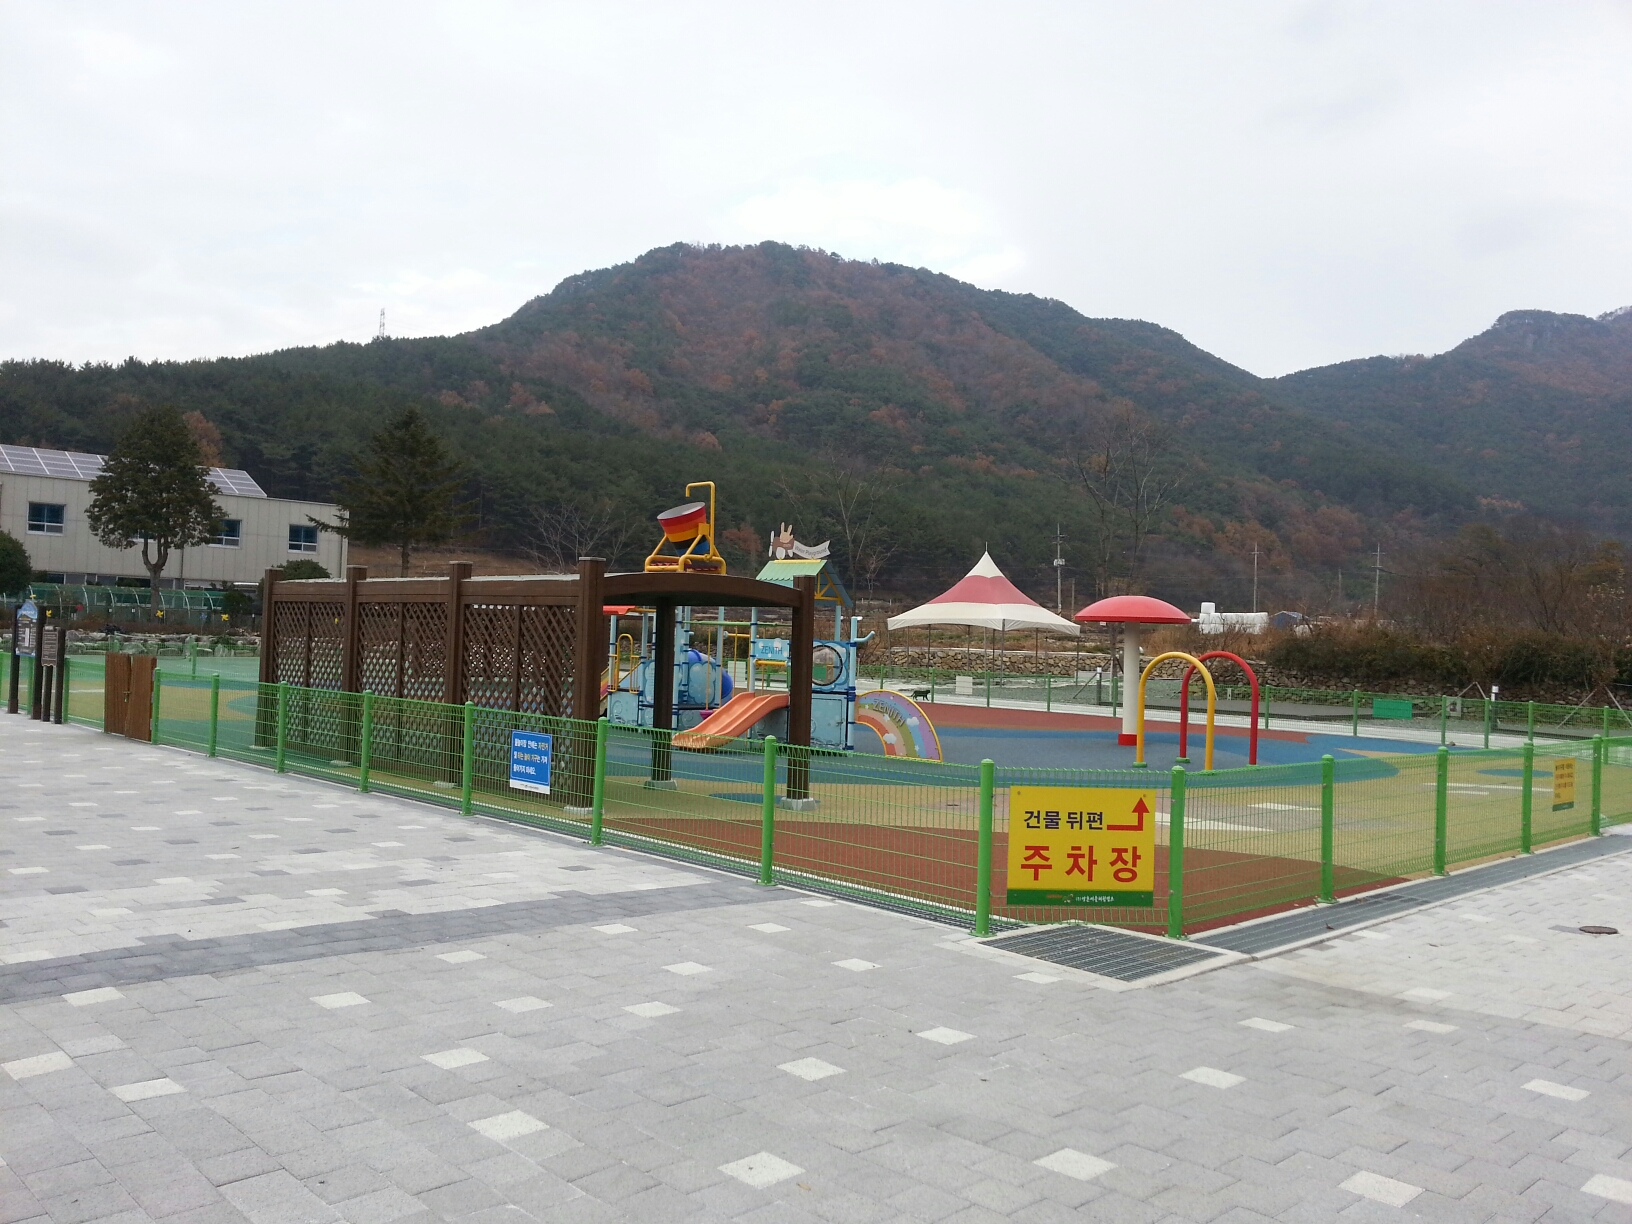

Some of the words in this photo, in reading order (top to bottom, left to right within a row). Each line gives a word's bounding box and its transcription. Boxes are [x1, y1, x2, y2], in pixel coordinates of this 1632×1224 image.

[761, 645, 783, 655] ZENITH
[873, 699, 905, 727] ZENITH
[1023, 810, 1062, 830] 건물
[1066, 811, 1103, 830] 뒤편
[1020, 845, 1142, 883] 주차장
